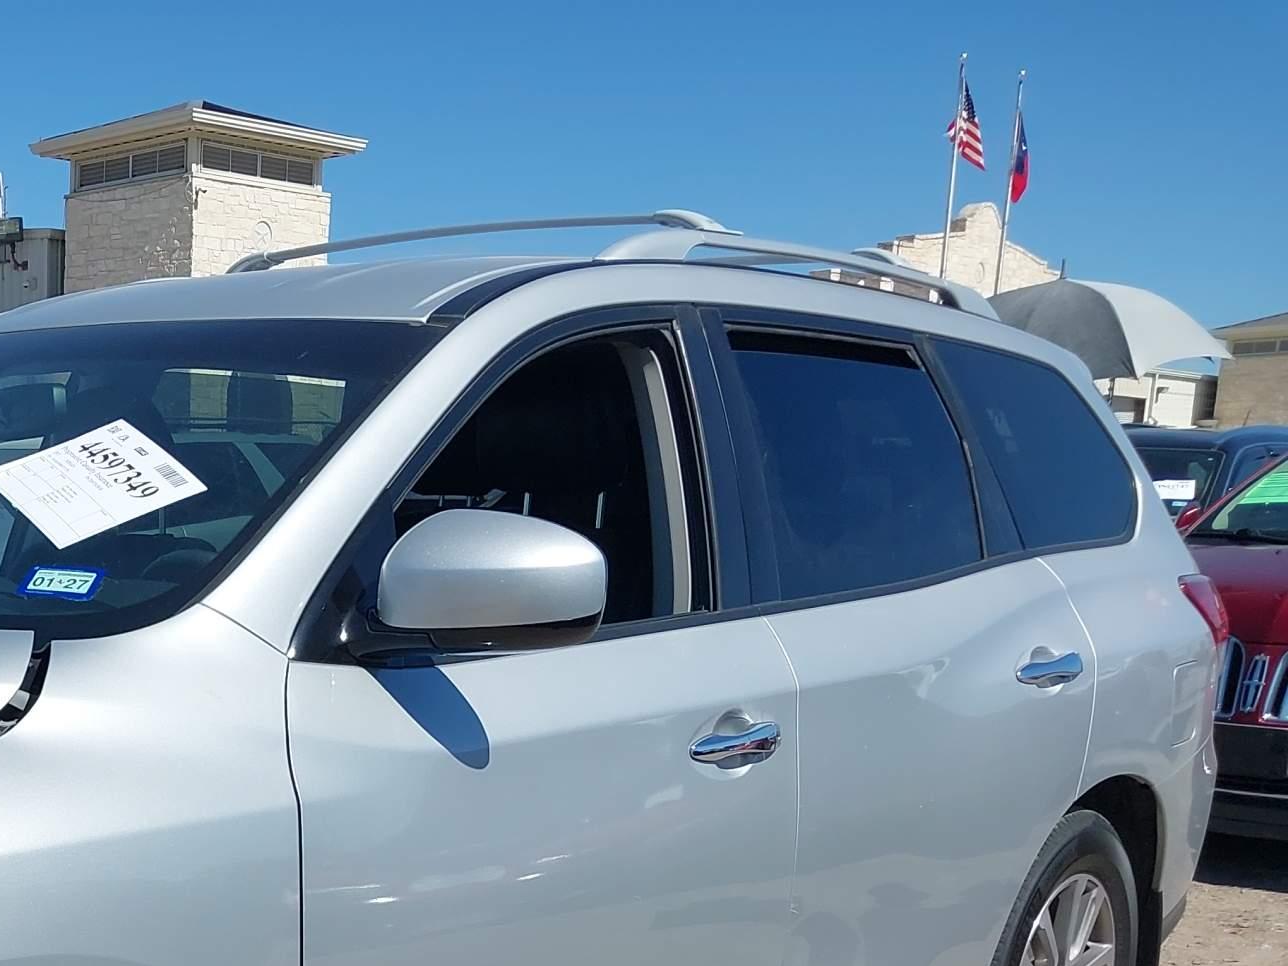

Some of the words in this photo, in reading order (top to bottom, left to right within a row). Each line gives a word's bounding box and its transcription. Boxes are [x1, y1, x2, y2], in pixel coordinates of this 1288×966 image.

[78, 441, 160, 498] 44597349
[32, 576, 56, 588] 01
[63, 578, 91, 590] 27
